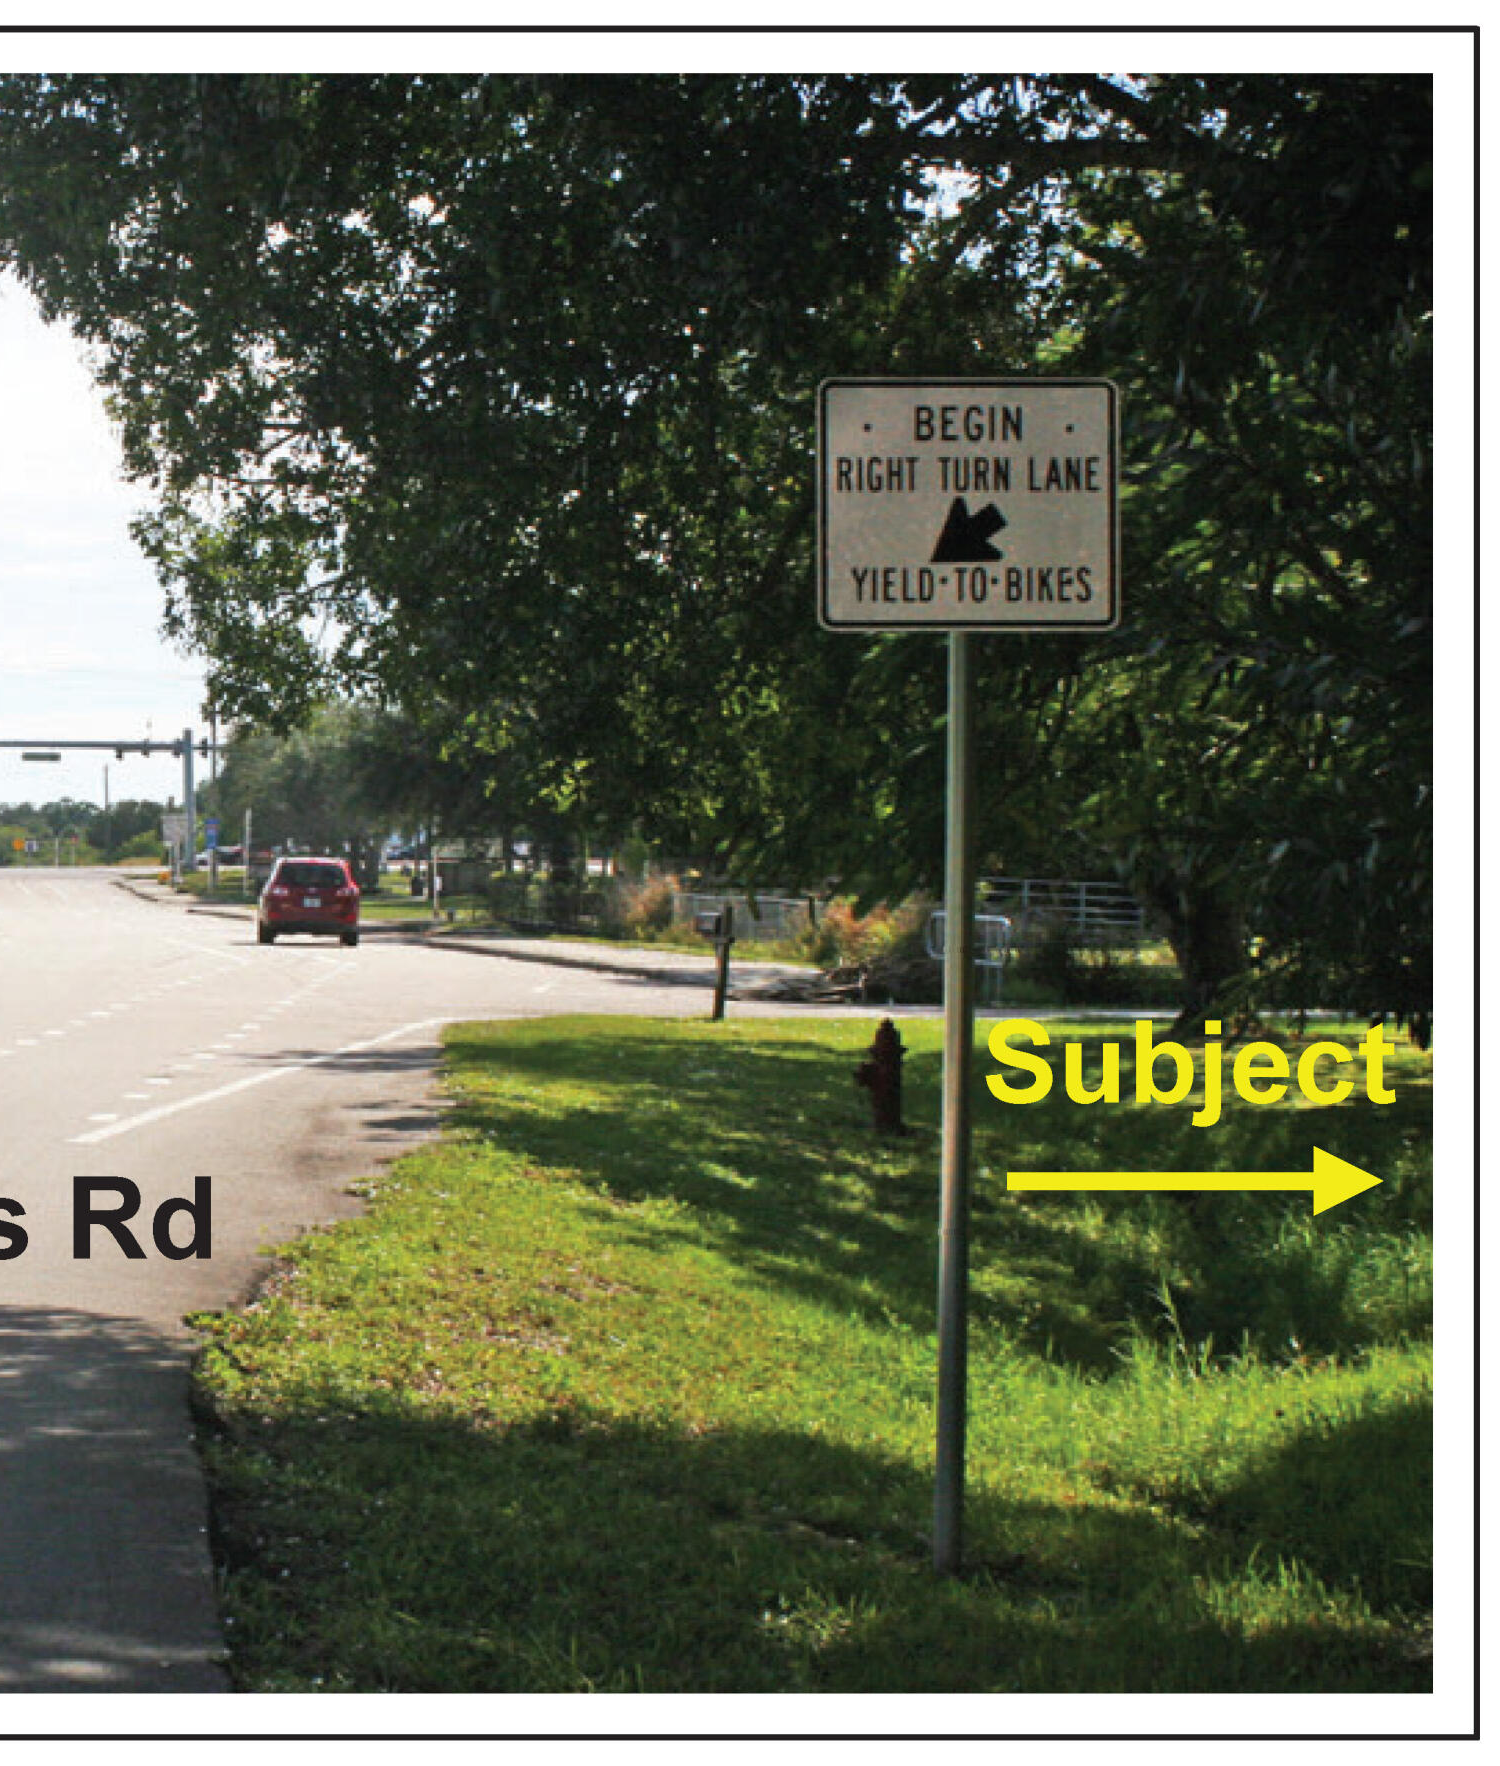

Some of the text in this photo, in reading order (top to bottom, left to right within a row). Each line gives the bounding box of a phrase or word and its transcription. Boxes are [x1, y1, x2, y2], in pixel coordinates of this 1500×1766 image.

[913, 405, 1023, 441] BEGIN
[836, 456, 1102, 493] RIGHT TURN LANE
[852, 566, 1092, 603] YIELD TO BIKES
